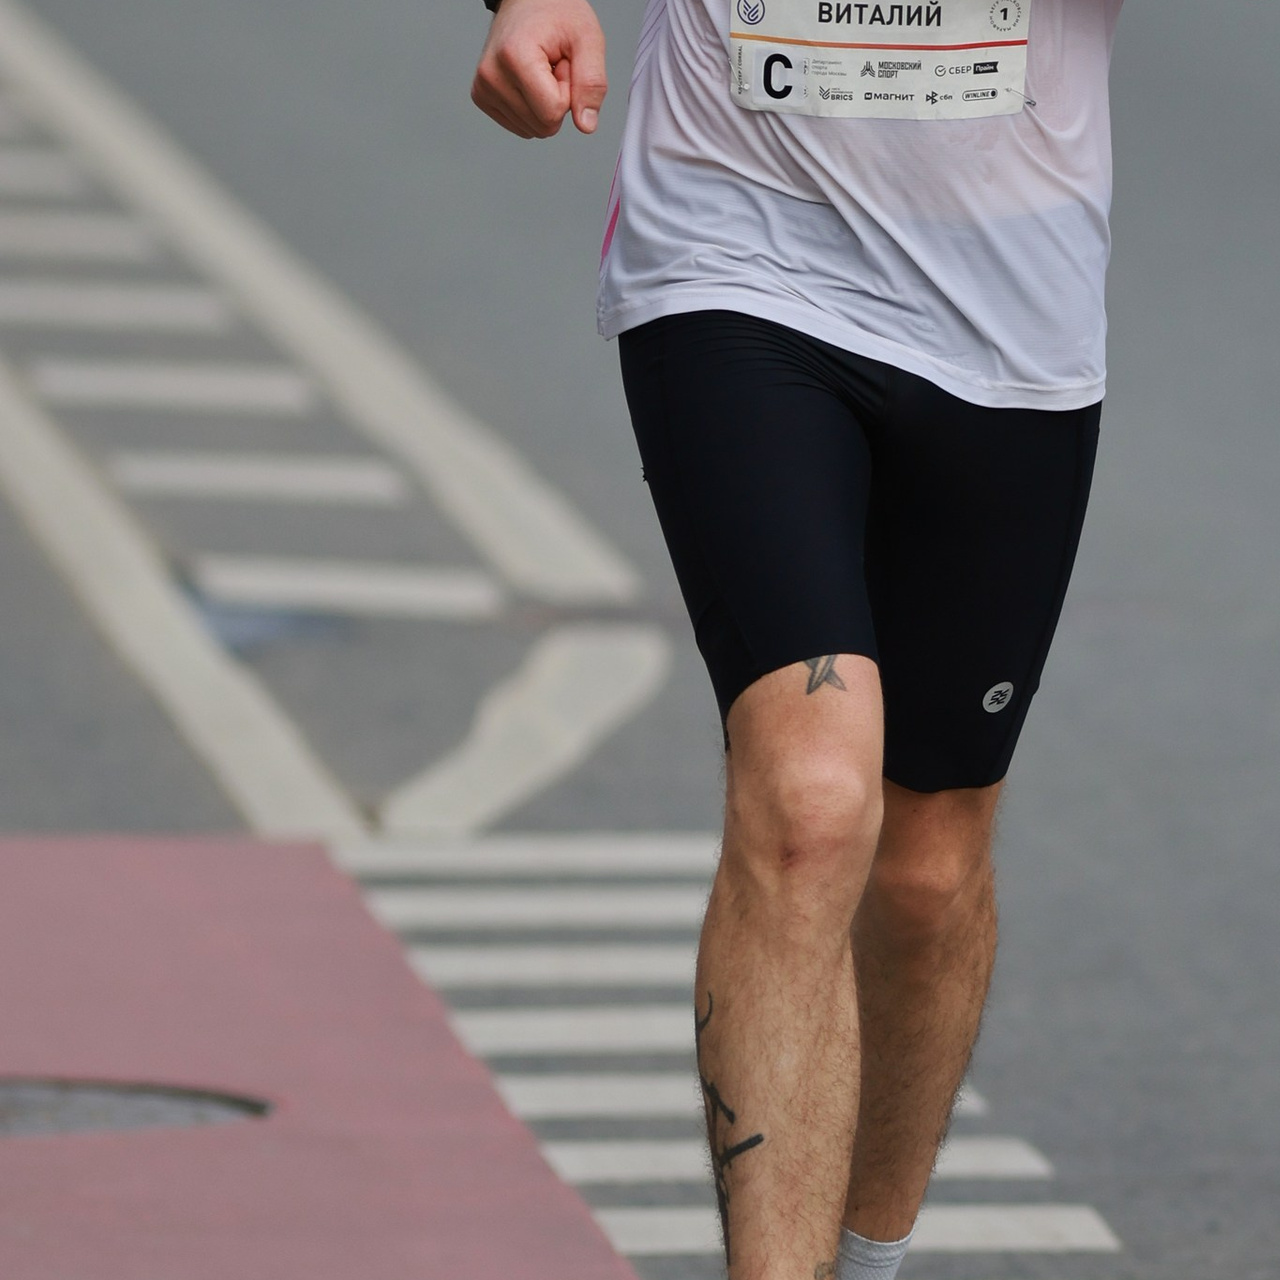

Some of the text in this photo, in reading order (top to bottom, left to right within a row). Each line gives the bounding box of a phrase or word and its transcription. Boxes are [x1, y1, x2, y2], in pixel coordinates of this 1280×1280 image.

[818, 0, 942, 27] ВИТАЛИЙ
[1000, 7, 1008, 21] 1
[878, 60, 922, 70] МОСКОВСКИЙ
[949, 65, 972, 75] СБЕР
[763, 53, 793, 99] C
[878, 70, 898, 78] СПОРТ
[939, 93, 953, 101] сбп
[965, 91, 990, 100] WINLINE
